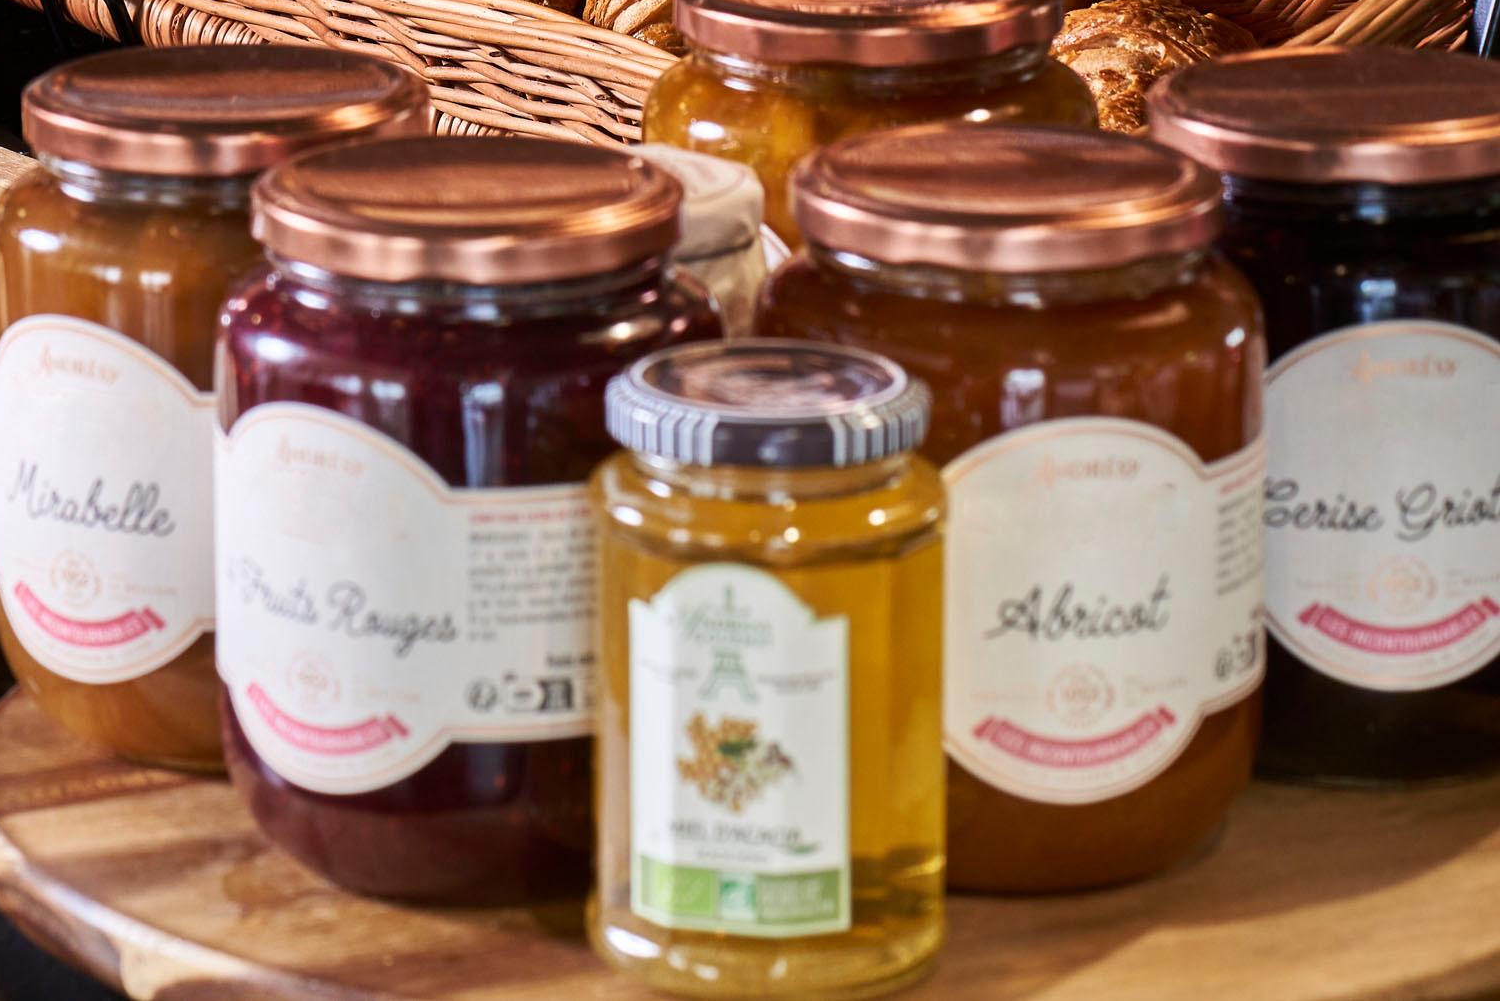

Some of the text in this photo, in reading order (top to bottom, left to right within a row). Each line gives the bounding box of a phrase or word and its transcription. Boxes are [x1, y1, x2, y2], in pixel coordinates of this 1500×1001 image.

[7, 459, 176, 538] Mirabelle
[1263, 477, 1383, 533] Cerise
[327, 580, 458, 658] Rouges
[982, 573, 1174, 642] Abricot
